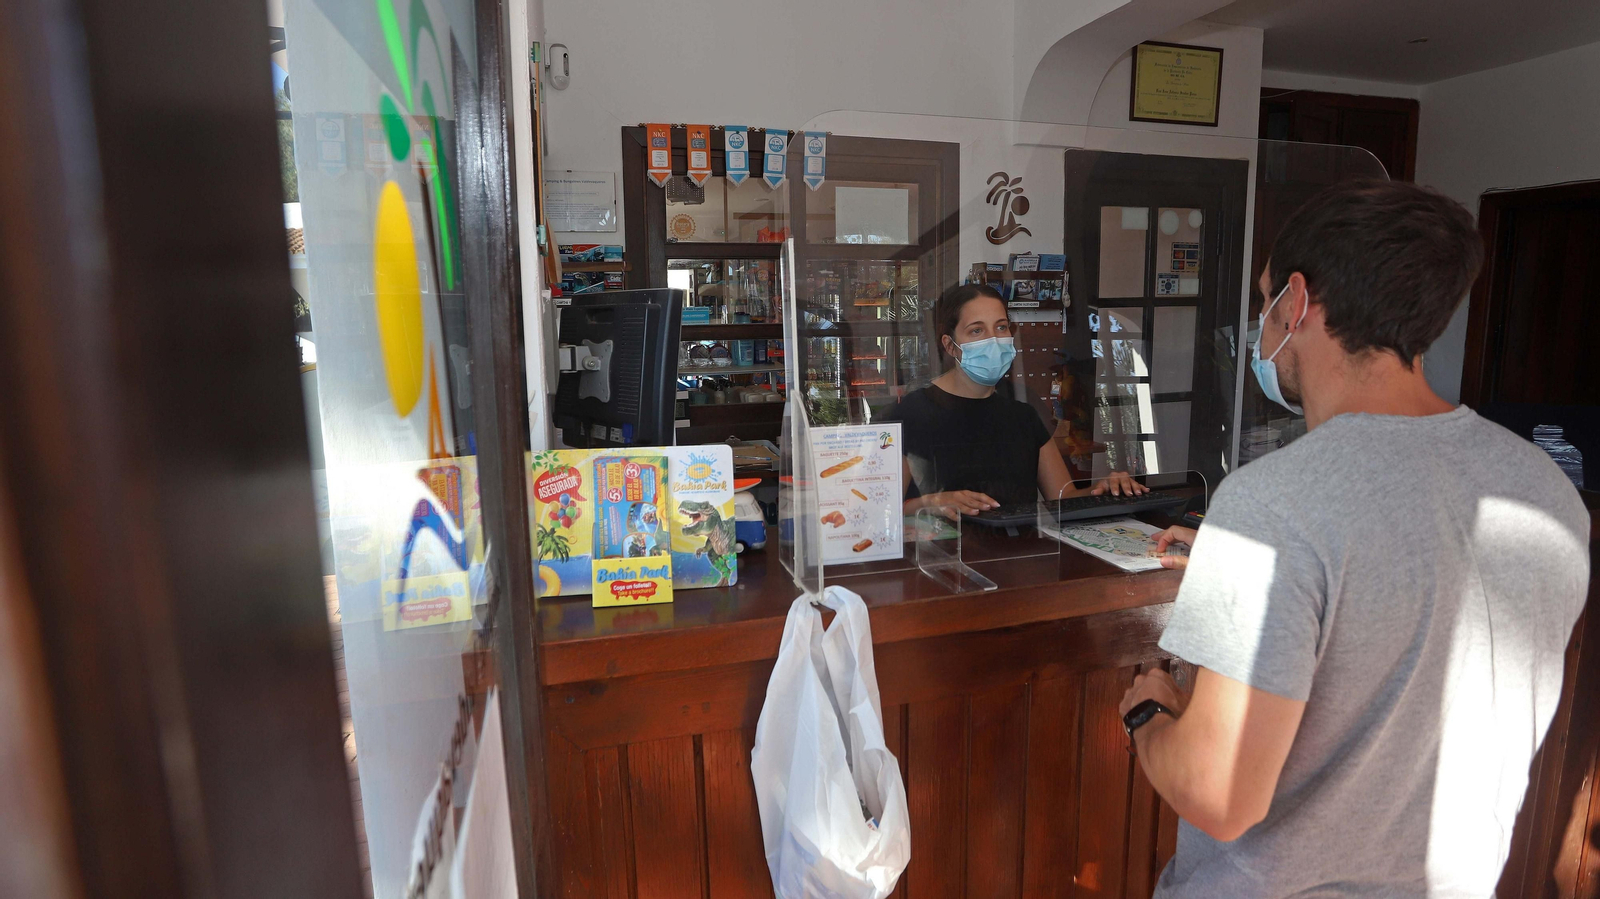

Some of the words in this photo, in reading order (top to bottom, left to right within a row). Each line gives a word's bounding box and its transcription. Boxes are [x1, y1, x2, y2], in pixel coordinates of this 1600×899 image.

[539, 474, 569, 486] DIVERSIÓN
[672, 481, 703, 492] Bahía
[704, 481, 727, 491] Park
[538, 477, 578, 499] ASEGURADA
[596, 567, 636, 583] Bahía
[640, 565, 669, 580] Park
